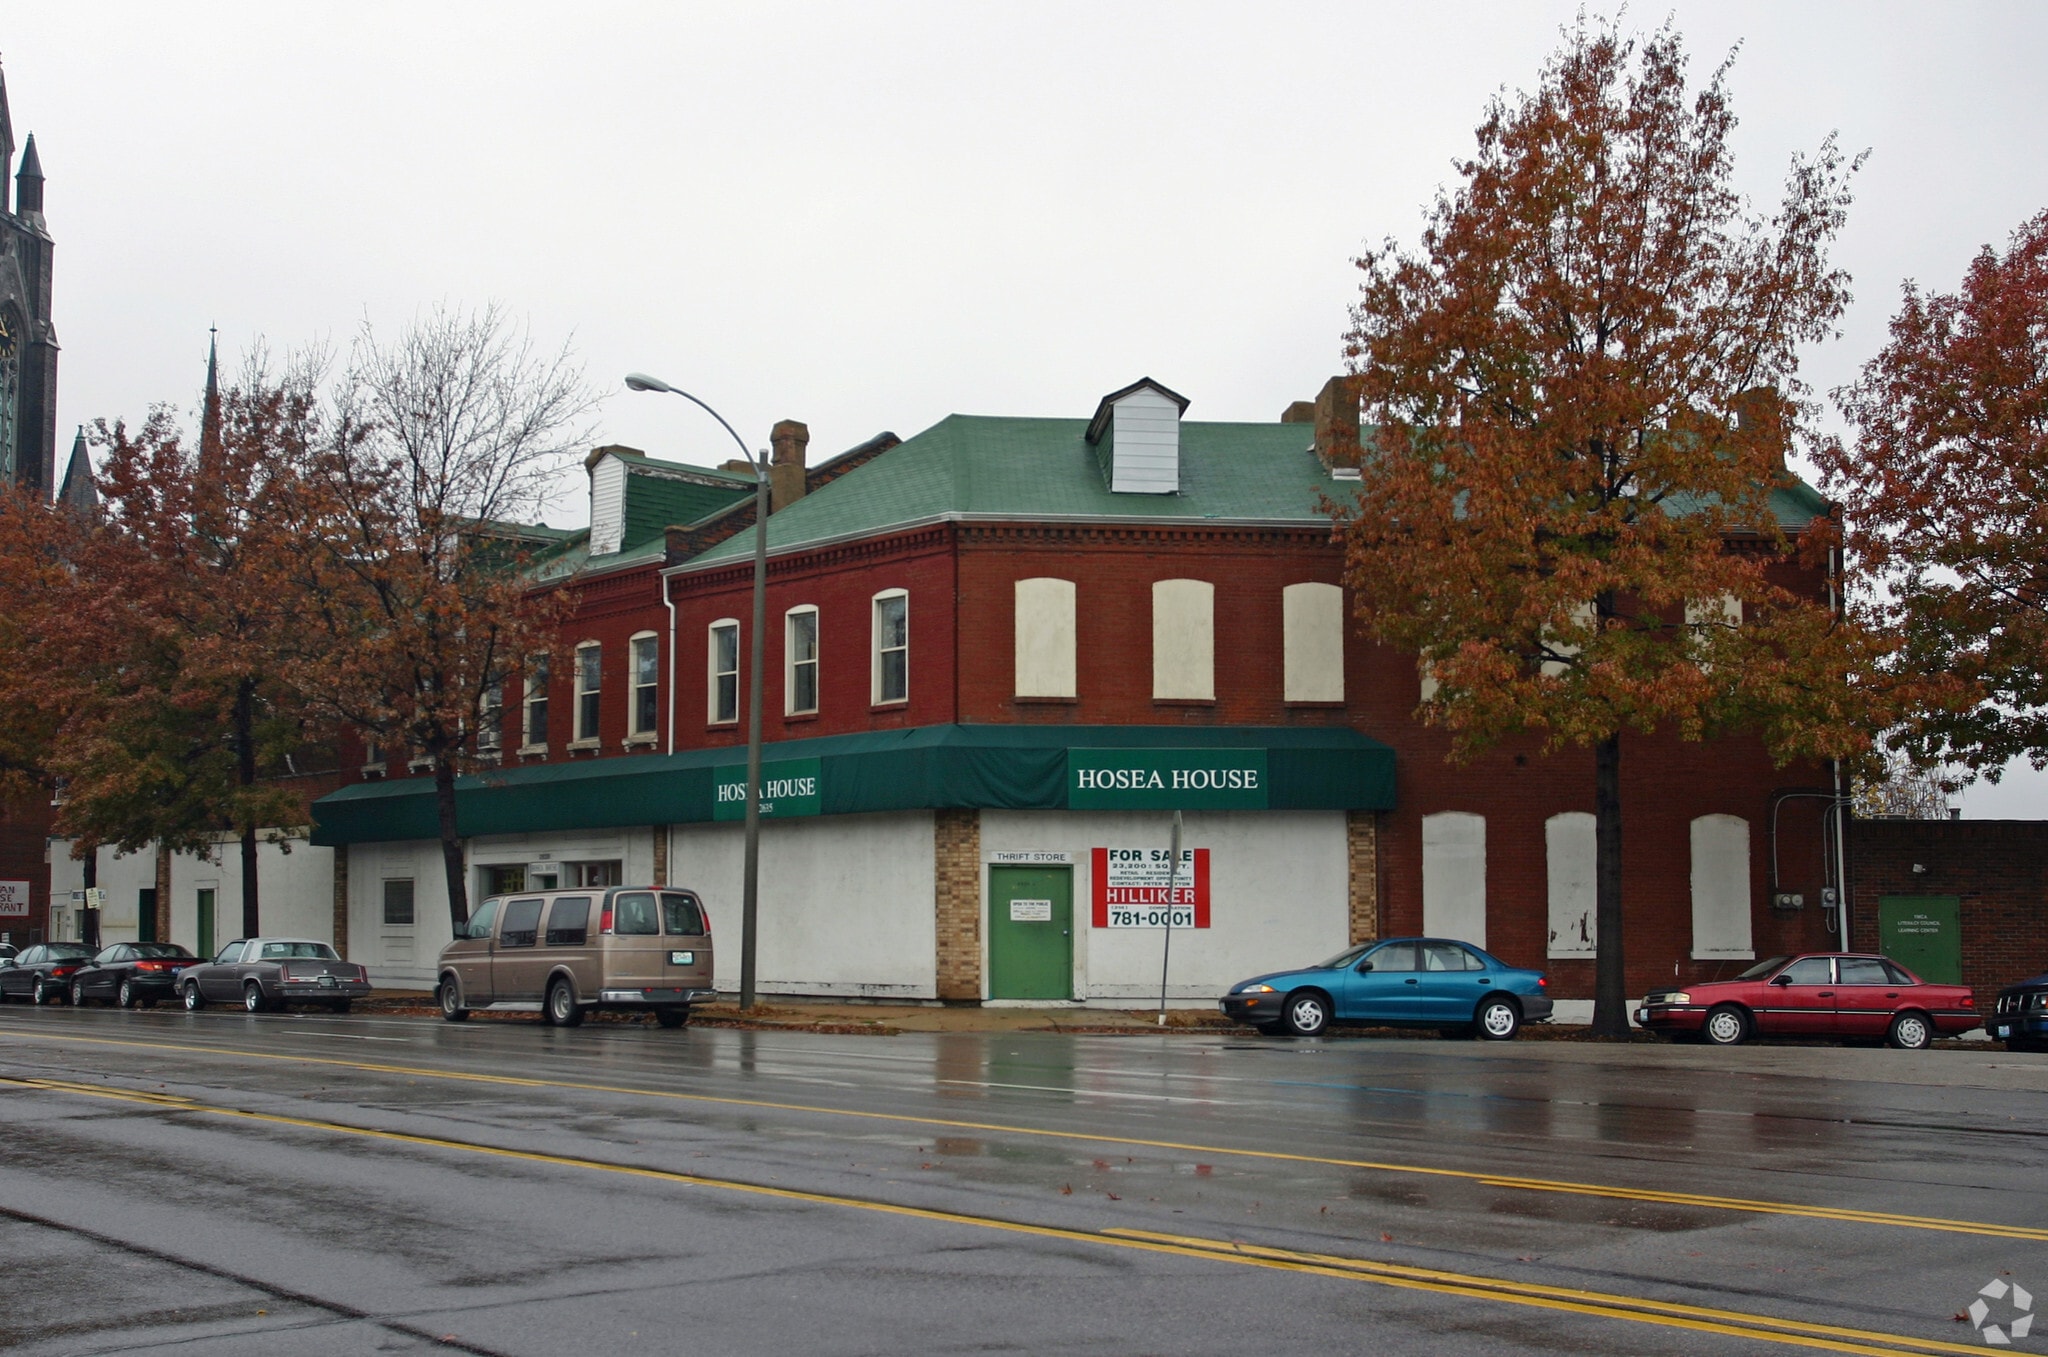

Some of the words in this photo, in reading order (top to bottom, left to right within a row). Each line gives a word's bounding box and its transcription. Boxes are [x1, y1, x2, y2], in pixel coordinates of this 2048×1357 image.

[1077, 769, 1165, 789] HOSEA
[1171, 769, 1258, 789] HOUSE
[718, 782, 764, 801] HOSA
[767, 777, 816, 799] HOUSE
[997, 853, 1030, 861] THRIFT
[1033, 853, 1066, 861] STORE
[1109, 850, 1142, 861] FOR
[1150, 850, 1192, 861] SAE
[1106, 888, 1195, 903] HILLIKER
[1111, 911, 1192, 926] 781-0001
